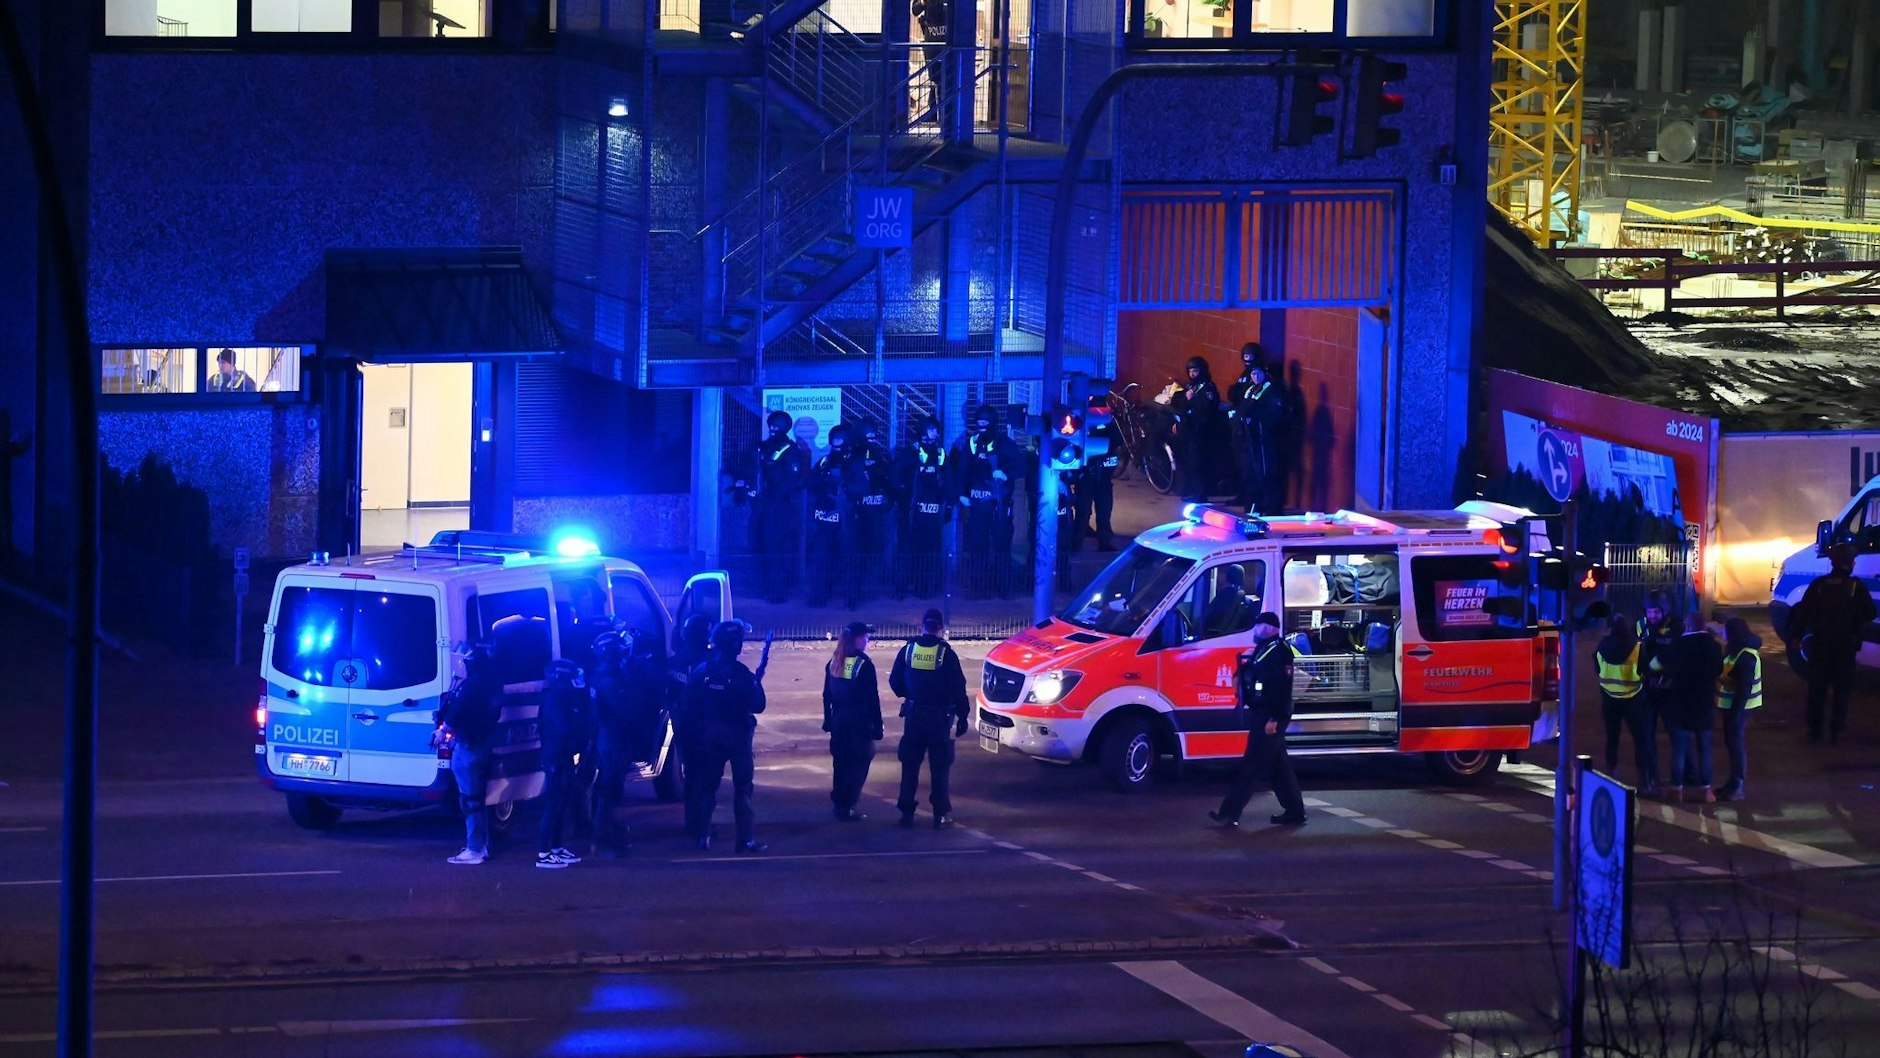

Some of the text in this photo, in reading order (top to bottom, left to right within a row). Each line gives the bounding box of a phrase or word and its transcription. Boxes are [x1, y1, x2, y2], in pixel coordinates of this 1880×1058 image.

[928, 26, 947, 36] POLIZ
[867, 197, 902, 219] JW
[785, 395, 837, 404] KÖNIGREICHSSAAL
[811, 403, 834, 411] ZEUGEN
[1666, 420, 1703, 443] ab 2024
[918, 502, 940, 514] OLIZEI
[1446, 587, 1487, 598] FEUER IM
[1444, 598, 1485, 610] HERZEN
[913, 653, 935, 662] POLIZEI
[1424, 667, 1494, 677] FEUERWEHR
[273, 724, 338, 746] POLIZEI
